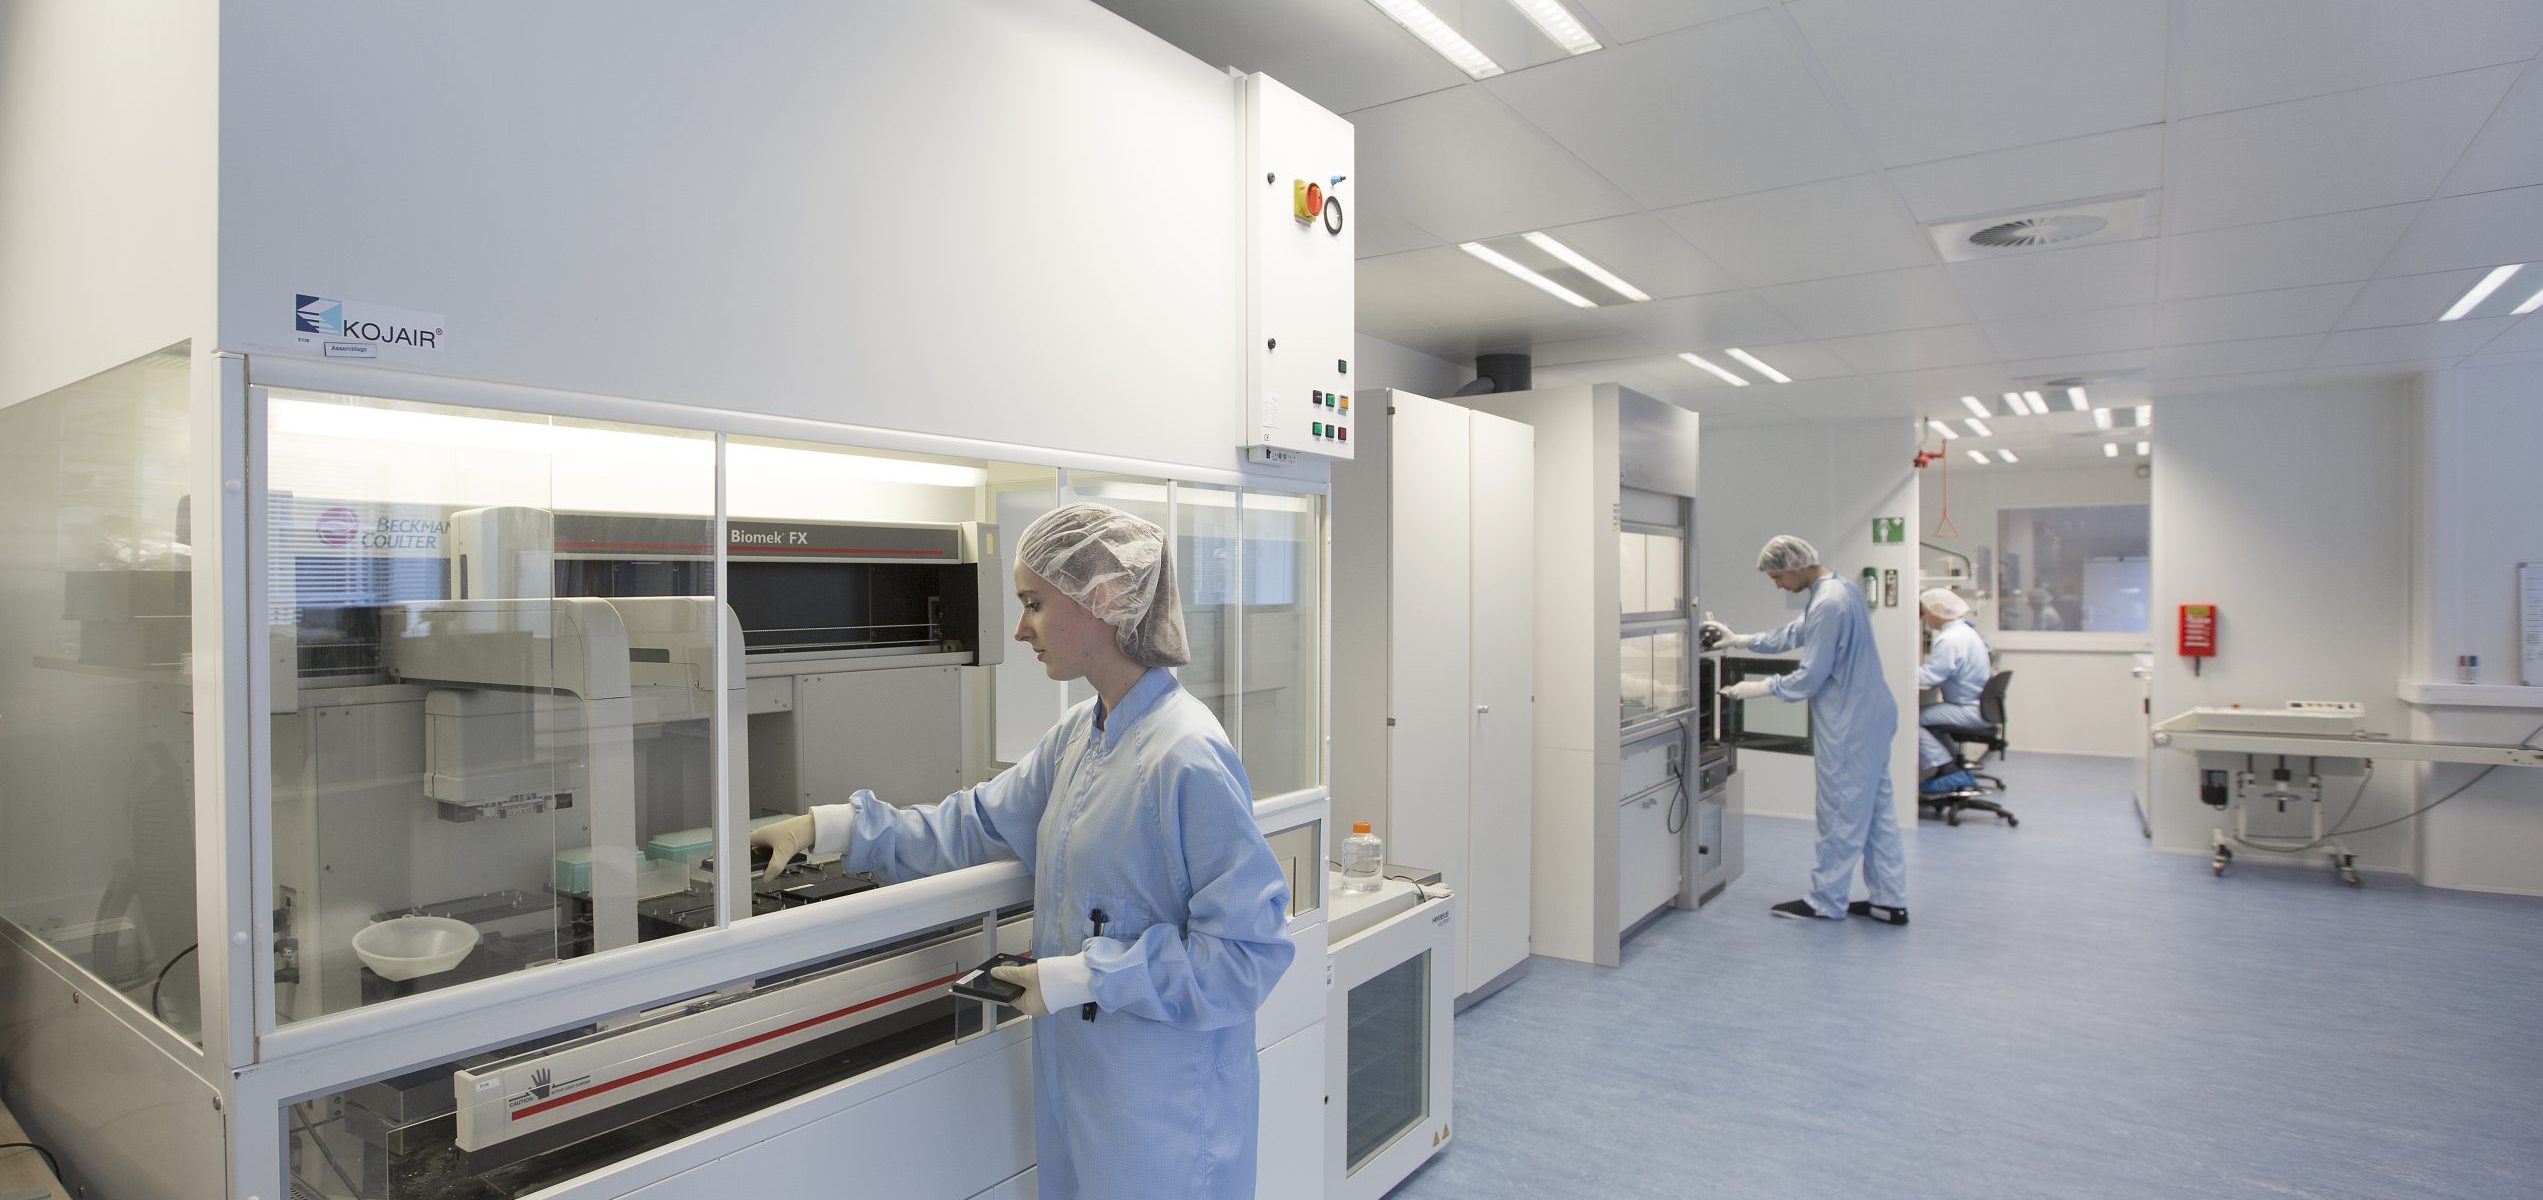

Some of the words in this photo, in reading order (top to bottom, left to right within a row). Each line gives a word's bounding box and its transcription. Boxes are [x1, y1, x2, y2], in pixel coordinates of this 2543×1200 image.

[361, 532, 436, 549] COULTER
[731, 529, 782, 544] Biomek
[789, 531, 808, 545] FX
